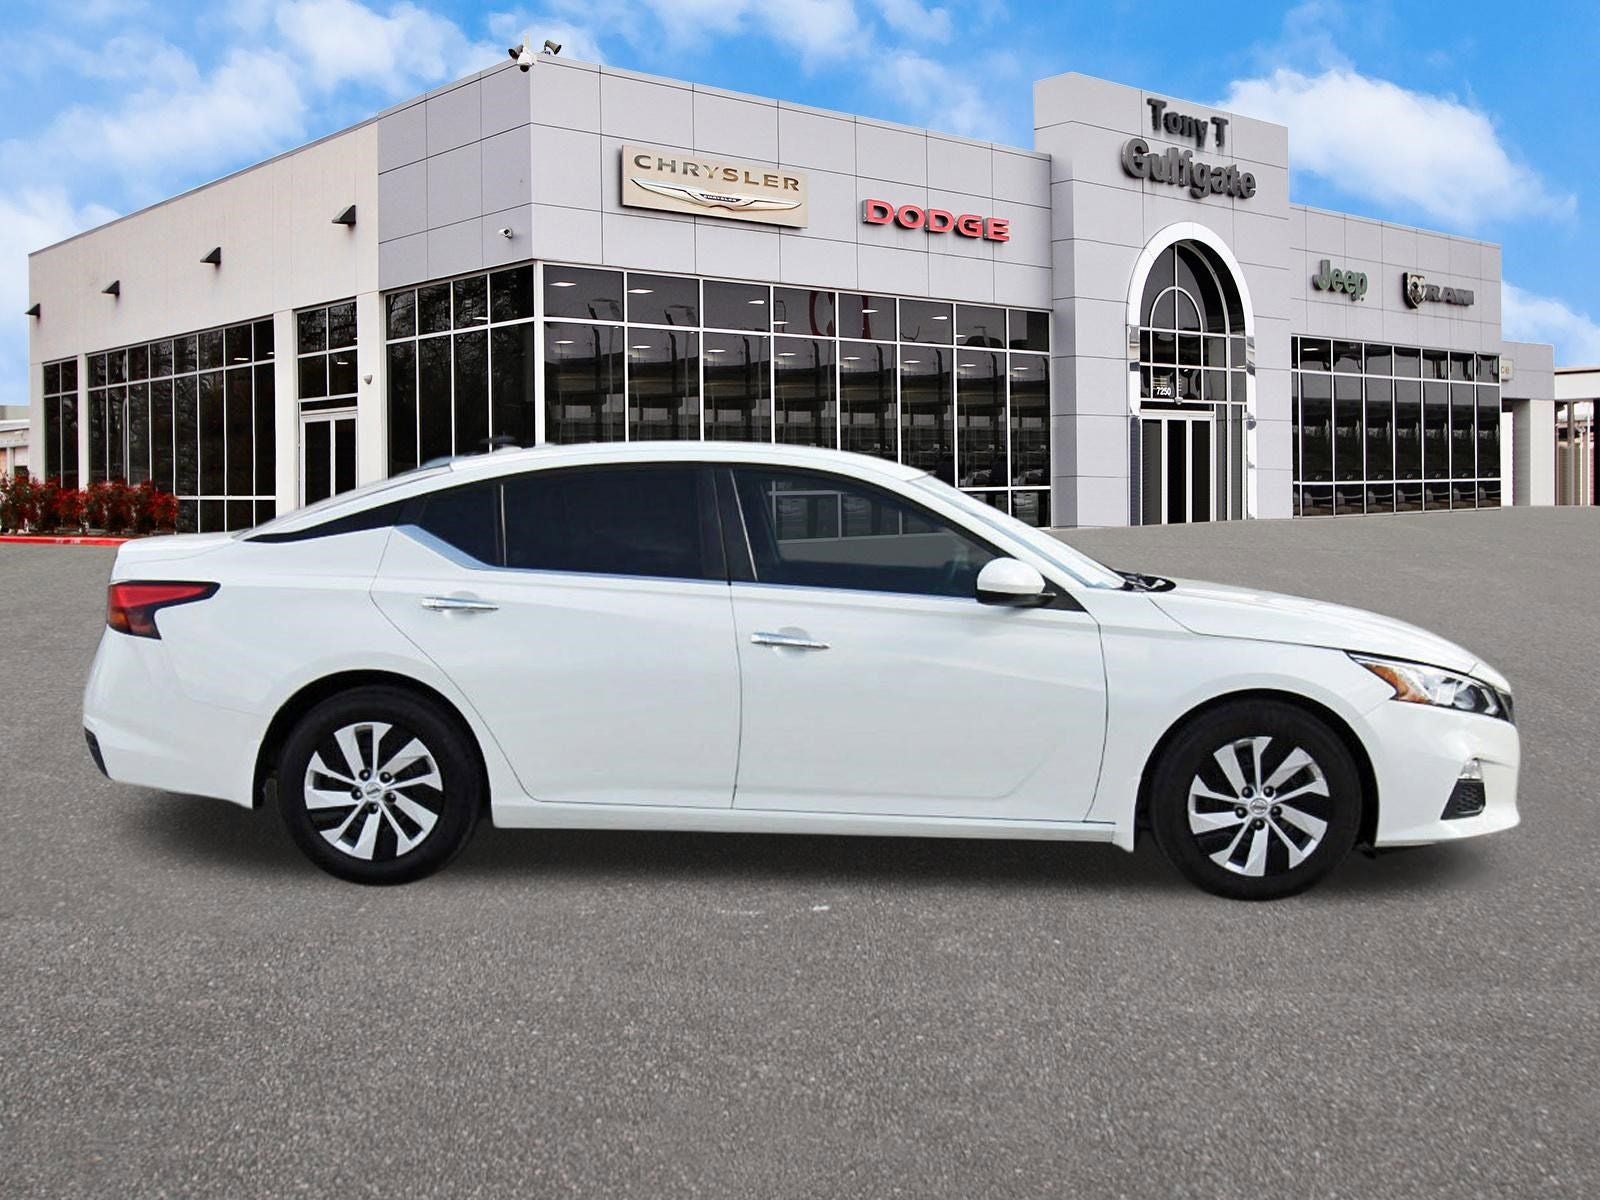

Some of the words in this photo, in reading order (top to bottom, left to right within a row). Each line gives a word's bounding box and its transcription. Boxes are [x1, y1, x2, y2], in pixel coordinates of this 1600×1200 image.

[1147, 98, 1208, 147] Tony
[1211, 116, 1229, 147] T
[633, 154, 800, 192] CHRYSLER
[1121, 138, 1256, 199] Gulfgate
[862, 199, 1010, 242] DODGE
[1312, 259, 1368, 302] Jeep
[1425, 284, 1474, 306] RAM
